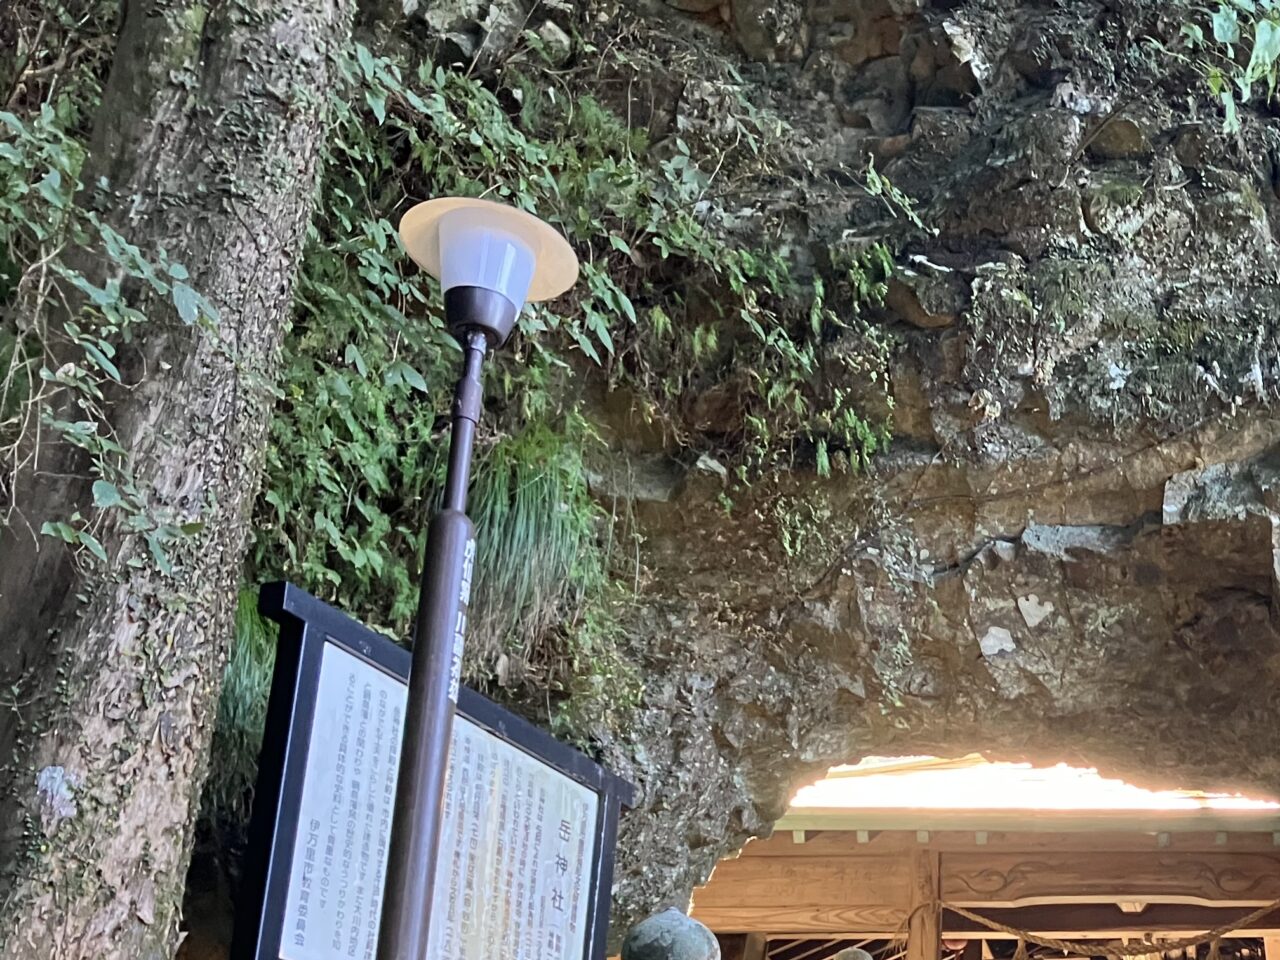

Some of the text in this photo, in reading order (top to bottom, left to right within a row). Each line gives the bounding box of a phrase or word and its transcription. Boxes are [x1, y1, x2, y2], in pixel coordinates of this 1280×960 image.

[293, 817, 321, 946] 伊万里市教育委員会
[550, 817, 573, 913] 岳神社
